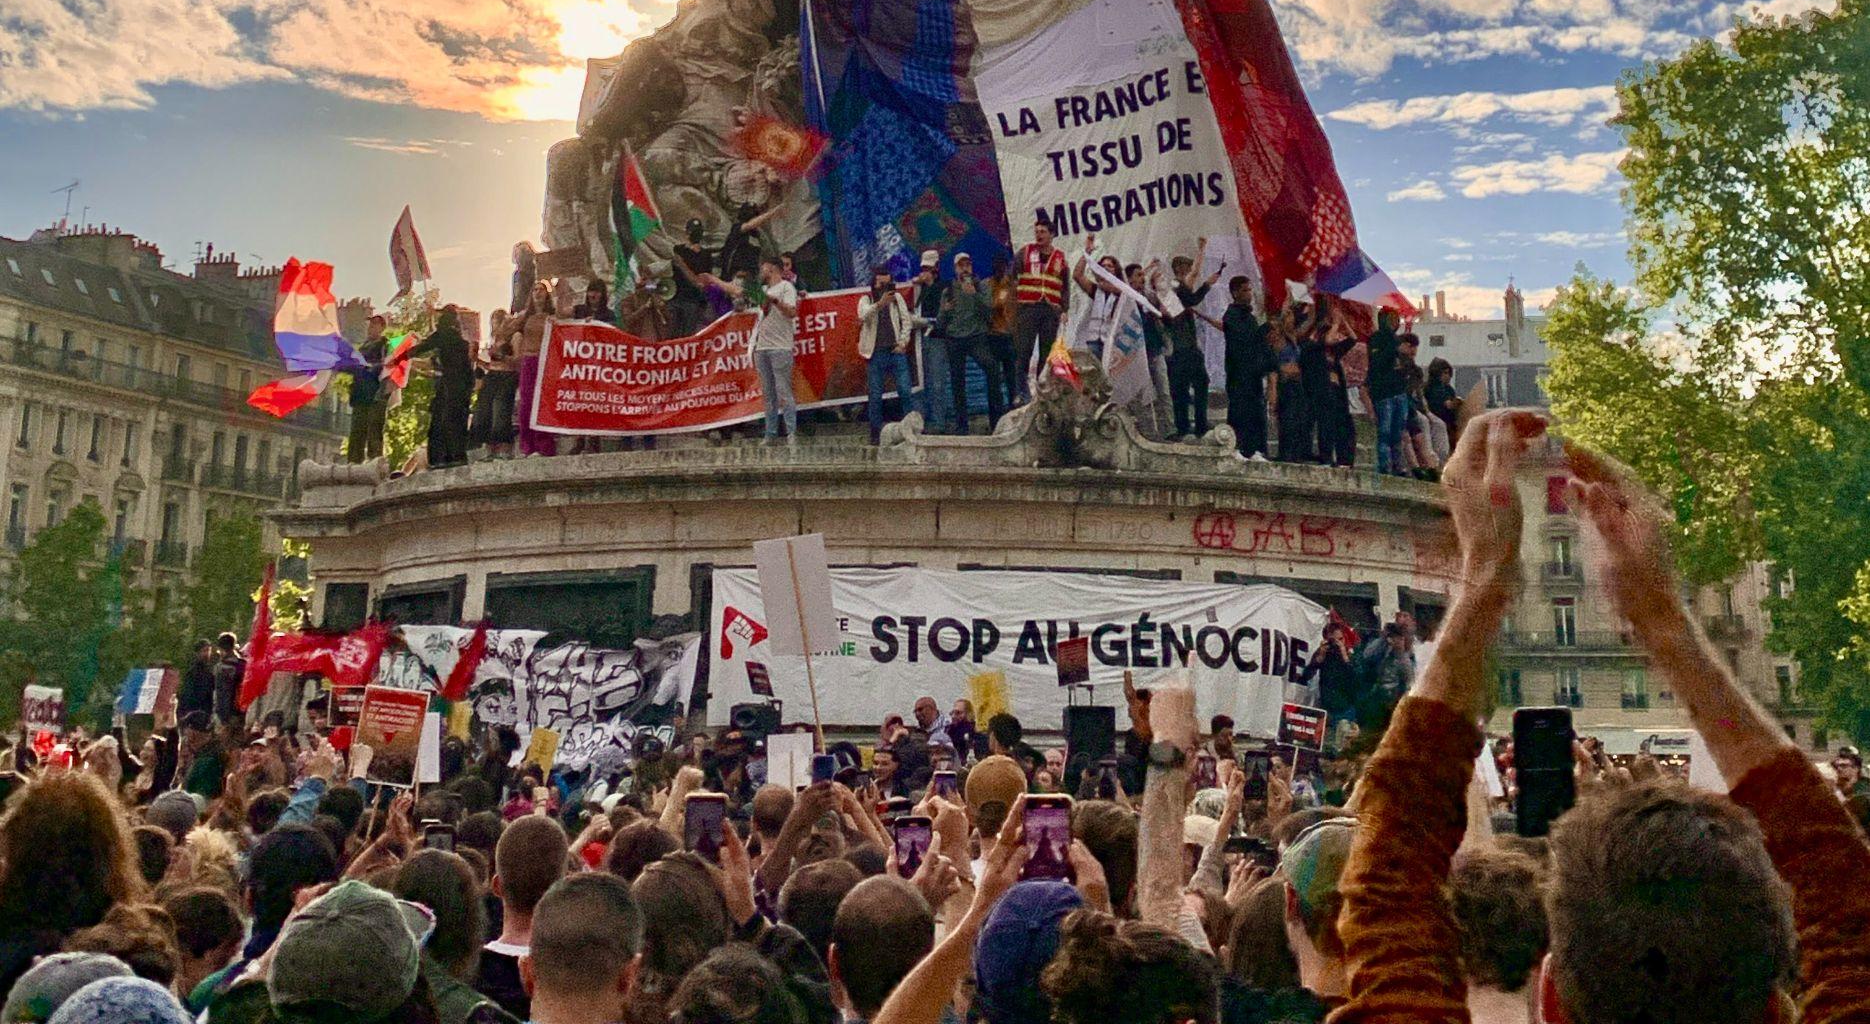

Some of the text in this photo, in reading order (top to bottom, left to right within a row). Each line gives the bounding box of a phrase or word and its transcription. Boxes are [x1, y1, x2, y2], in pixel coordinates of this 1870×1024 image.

[997, 107, 1041, 138] LA
[1054, 68, 1171, 129] FRANCE
[1046, 118, 1193, 181] TISSU DE
[1035, 172, 1225, 238] MIGRATIONS
[563, 340, 628, 363] NOTRE
[632, 342, 700, 365] FRONT
[805, 311, 838, 332] EST
[557, 389, 577, 400] PAR
[578, 390, 607, 402] TOUS
[608, 393, 625, 404] LES
[560, 364, 689, 385] ANTICOLONIAL
[692, 360, 710, 378] ET
[555, 401, 611, 414] STOPPONS
[664, 403, 679, 413] AU
[680, 395, 727, 410] POUVOIR
[729, 393, 743, 403] DU
[869, 615, 1001, 664] STOP
[1091, 611, 1312, 686] GÉNOCIDE
